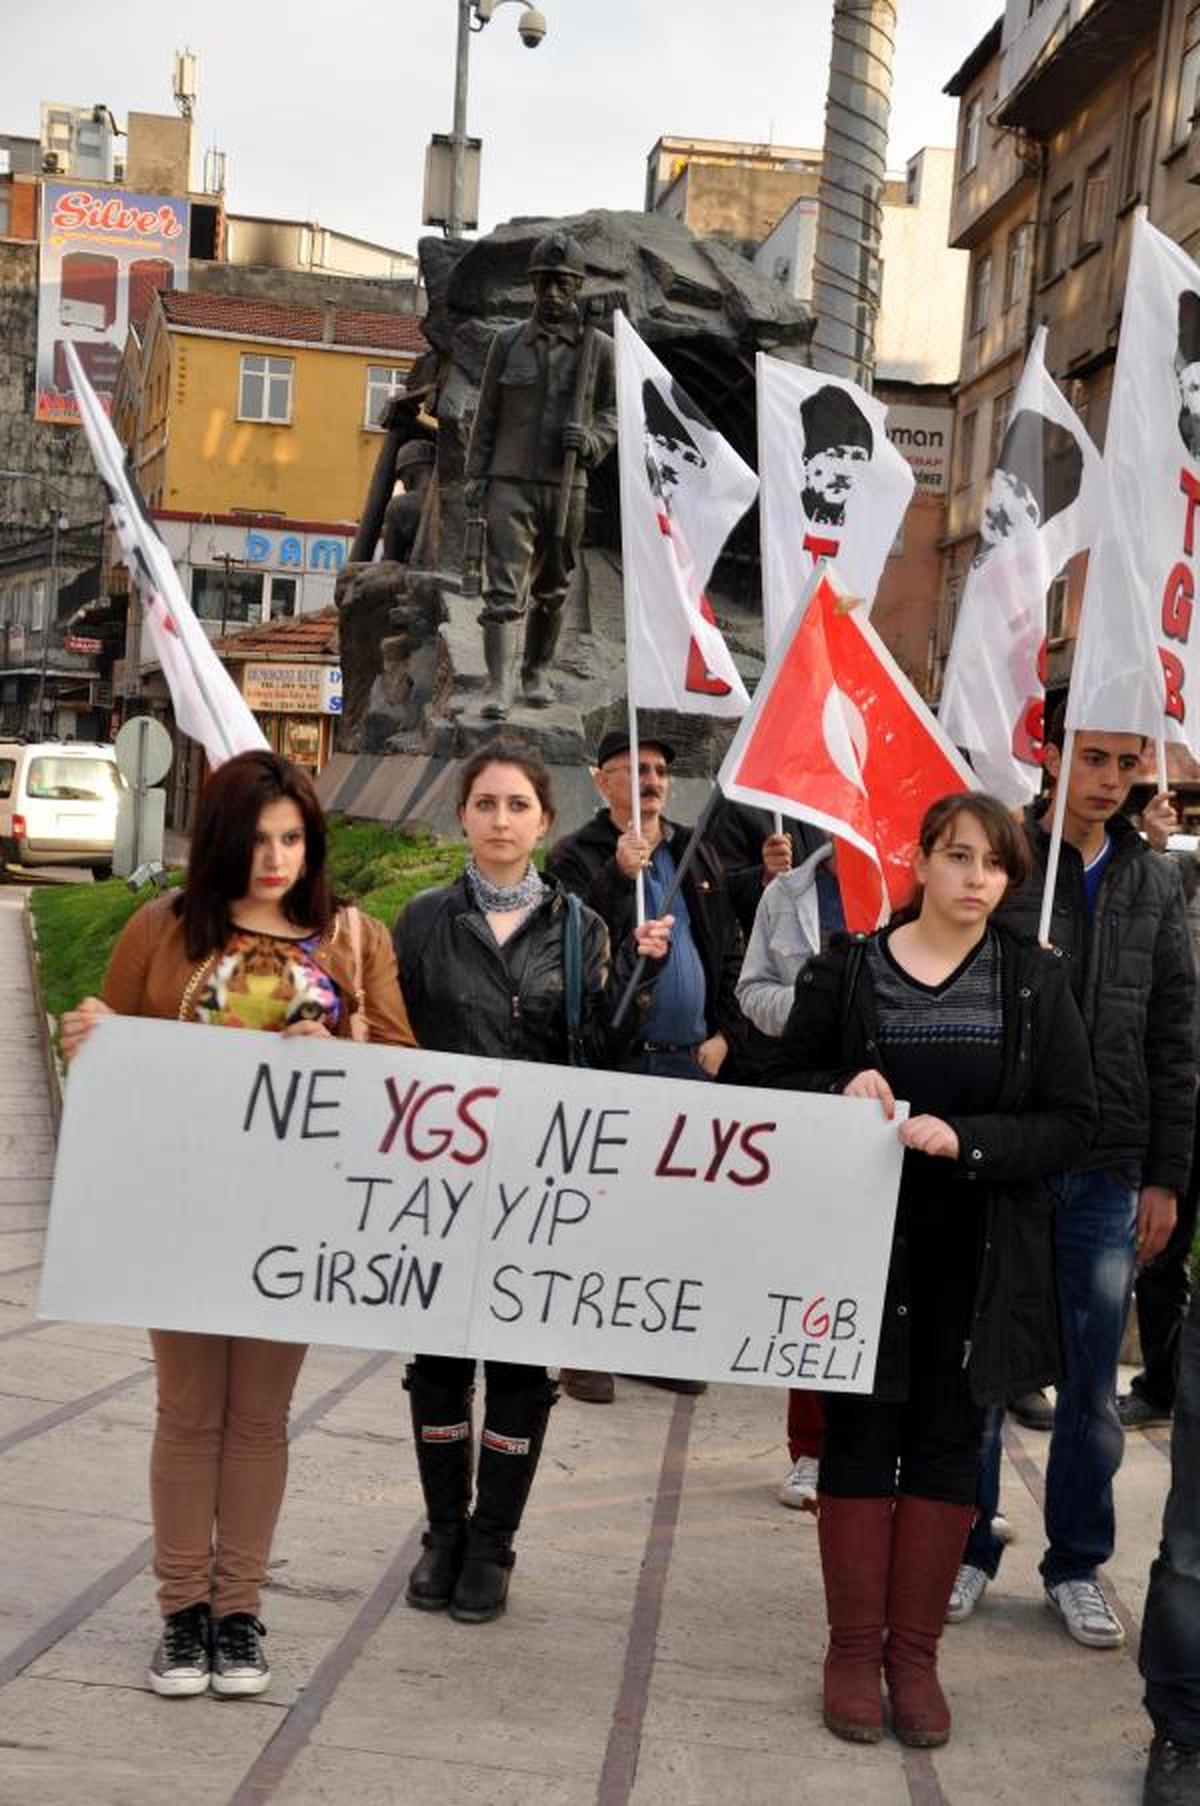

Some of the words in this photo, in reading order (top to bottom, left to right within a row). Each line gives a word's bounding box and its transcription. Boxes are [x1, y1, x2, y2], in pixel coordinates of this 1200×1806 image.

[52, 191, 182, 238] Silver
[886, 427, 943, 448] man
[243, 1063, 346, 1140] NE
[378, 1076, 501, 1166] YGS
[535, 1101, 628, 1175] NE
[654, 1113, 777, 1187] LYS
[490, 1264, 703, 1333] STRESE
[768, 1293, 857, 1341] TGB
